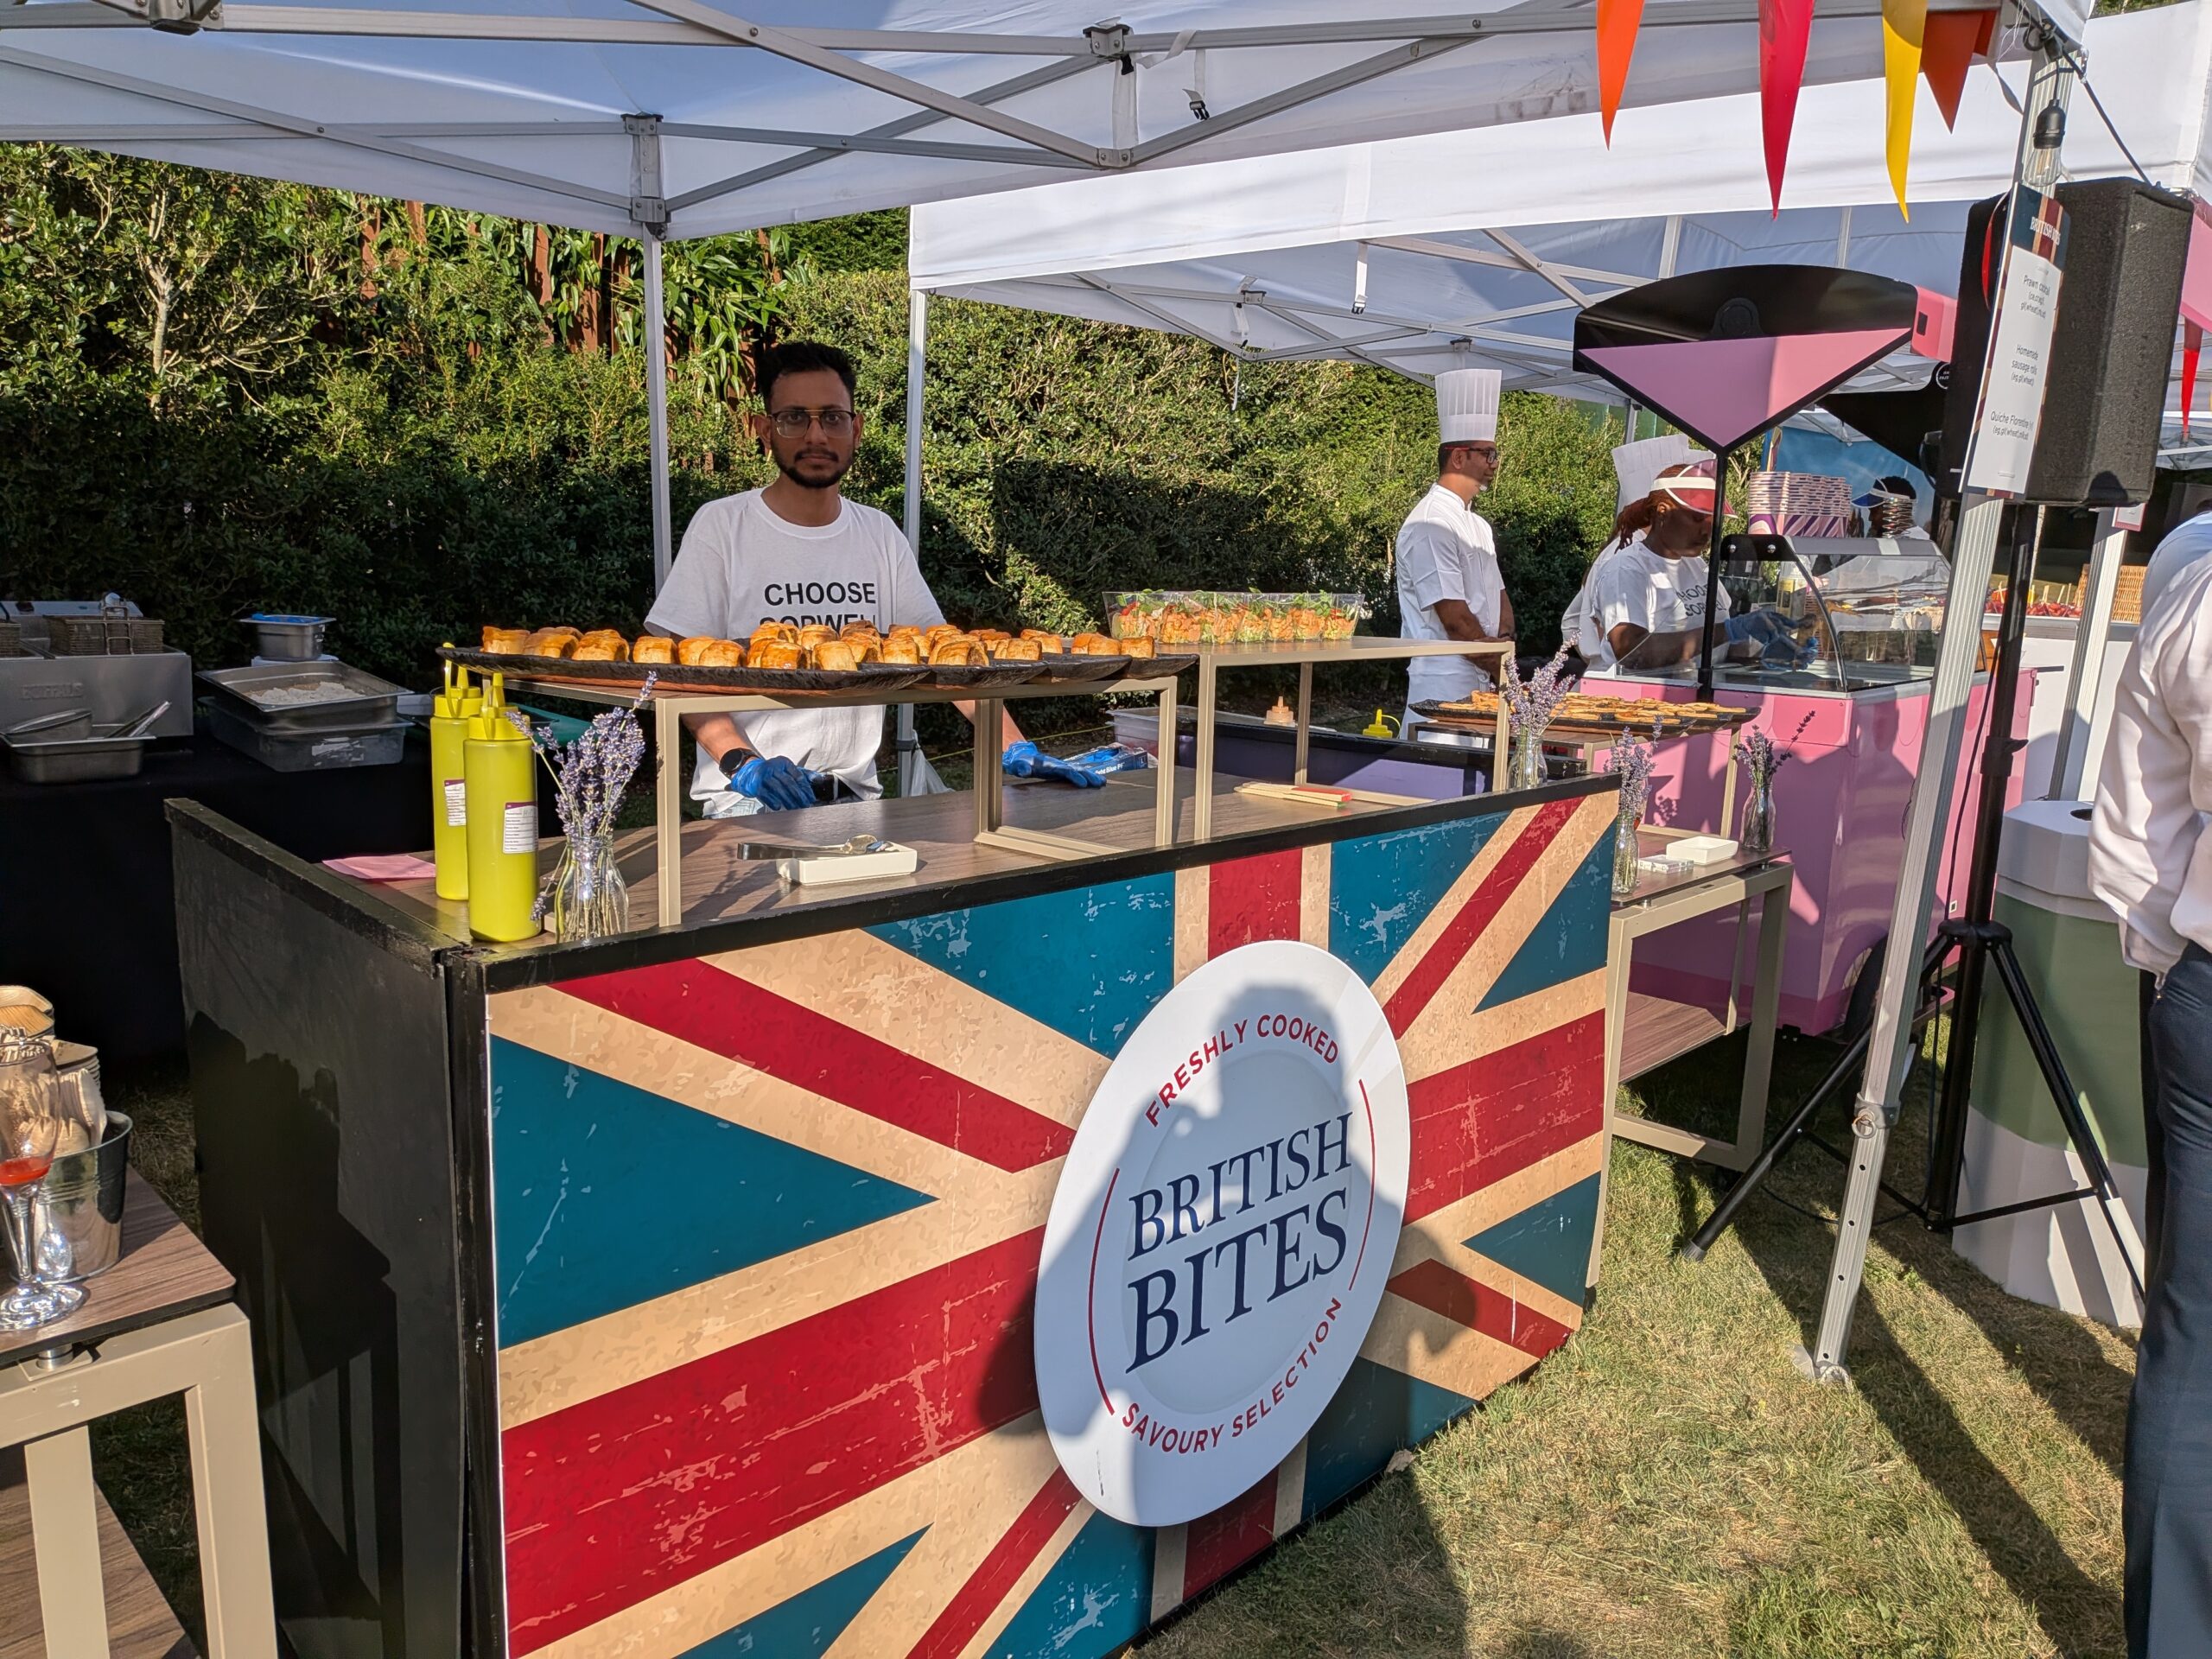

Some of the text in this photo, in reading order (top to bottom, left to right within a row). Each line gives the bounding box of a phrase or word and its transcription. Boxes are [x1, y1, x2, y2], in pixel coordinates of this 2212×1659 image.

[2030, 216, 2053, 239] BRITISH
[2023, 275, 2039, 289] Prawn
[2016, 344, 2039, 361] Homemade
[2012, 359, 2031, 373] sausage
[1990, 410, 2010, 424] Quiche
[764, 582, 876, 606] CHOOSE
[1145, 1014, 1339, 1128] FRESHLY COOKED
[1127, 1111, 1353, 1262] BRITISH
[1125, 1186, 1348, 1374] BITES
[1122, 1297, 1342, 1454] SAVOURY SELECTION
